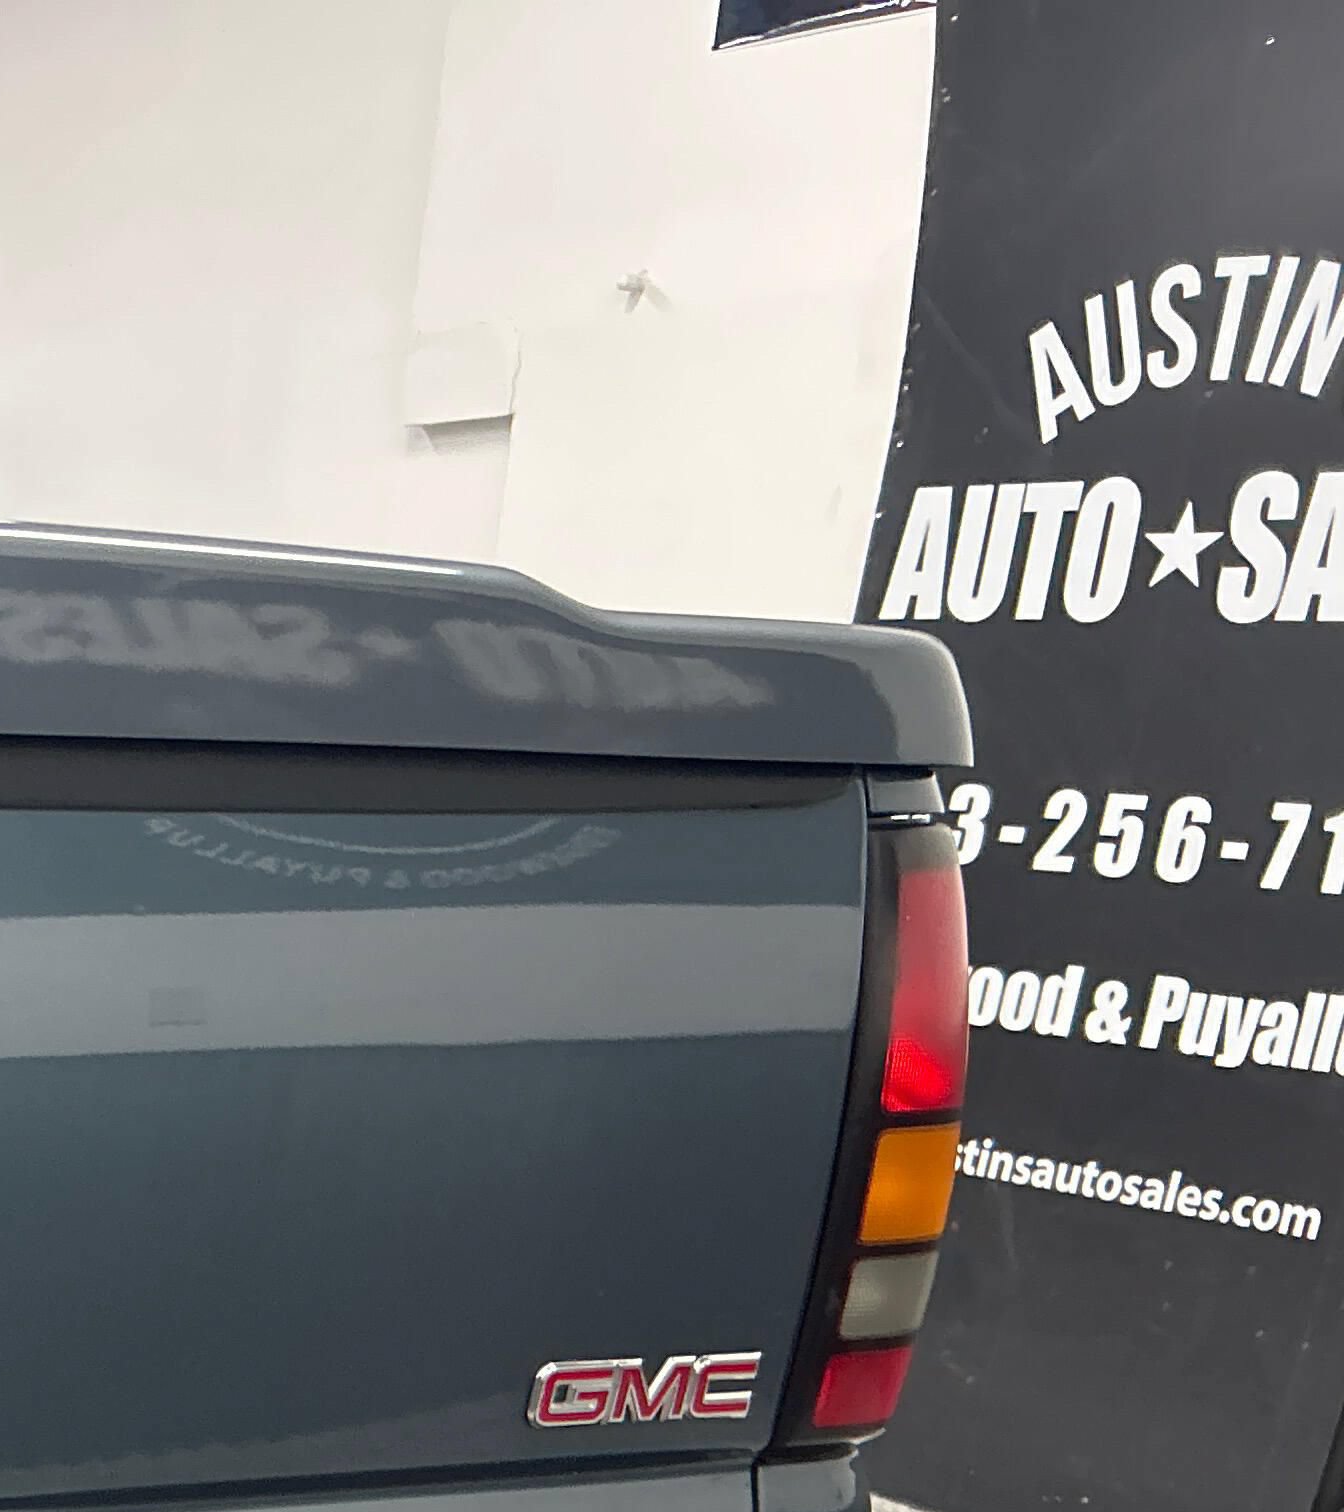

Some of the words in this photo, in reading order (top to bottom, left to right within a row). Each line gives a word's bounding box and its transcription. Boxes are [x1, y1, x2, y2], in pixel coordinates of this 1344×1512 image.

[879, 476, 1142, 624] AUTO
[968, 964, 1086, 1038] ood
[1084, 980, 1132, 1045] &
[1138, 974, 1344, 1077] Puyall
[527, 1351, 761, 1427] GMC
